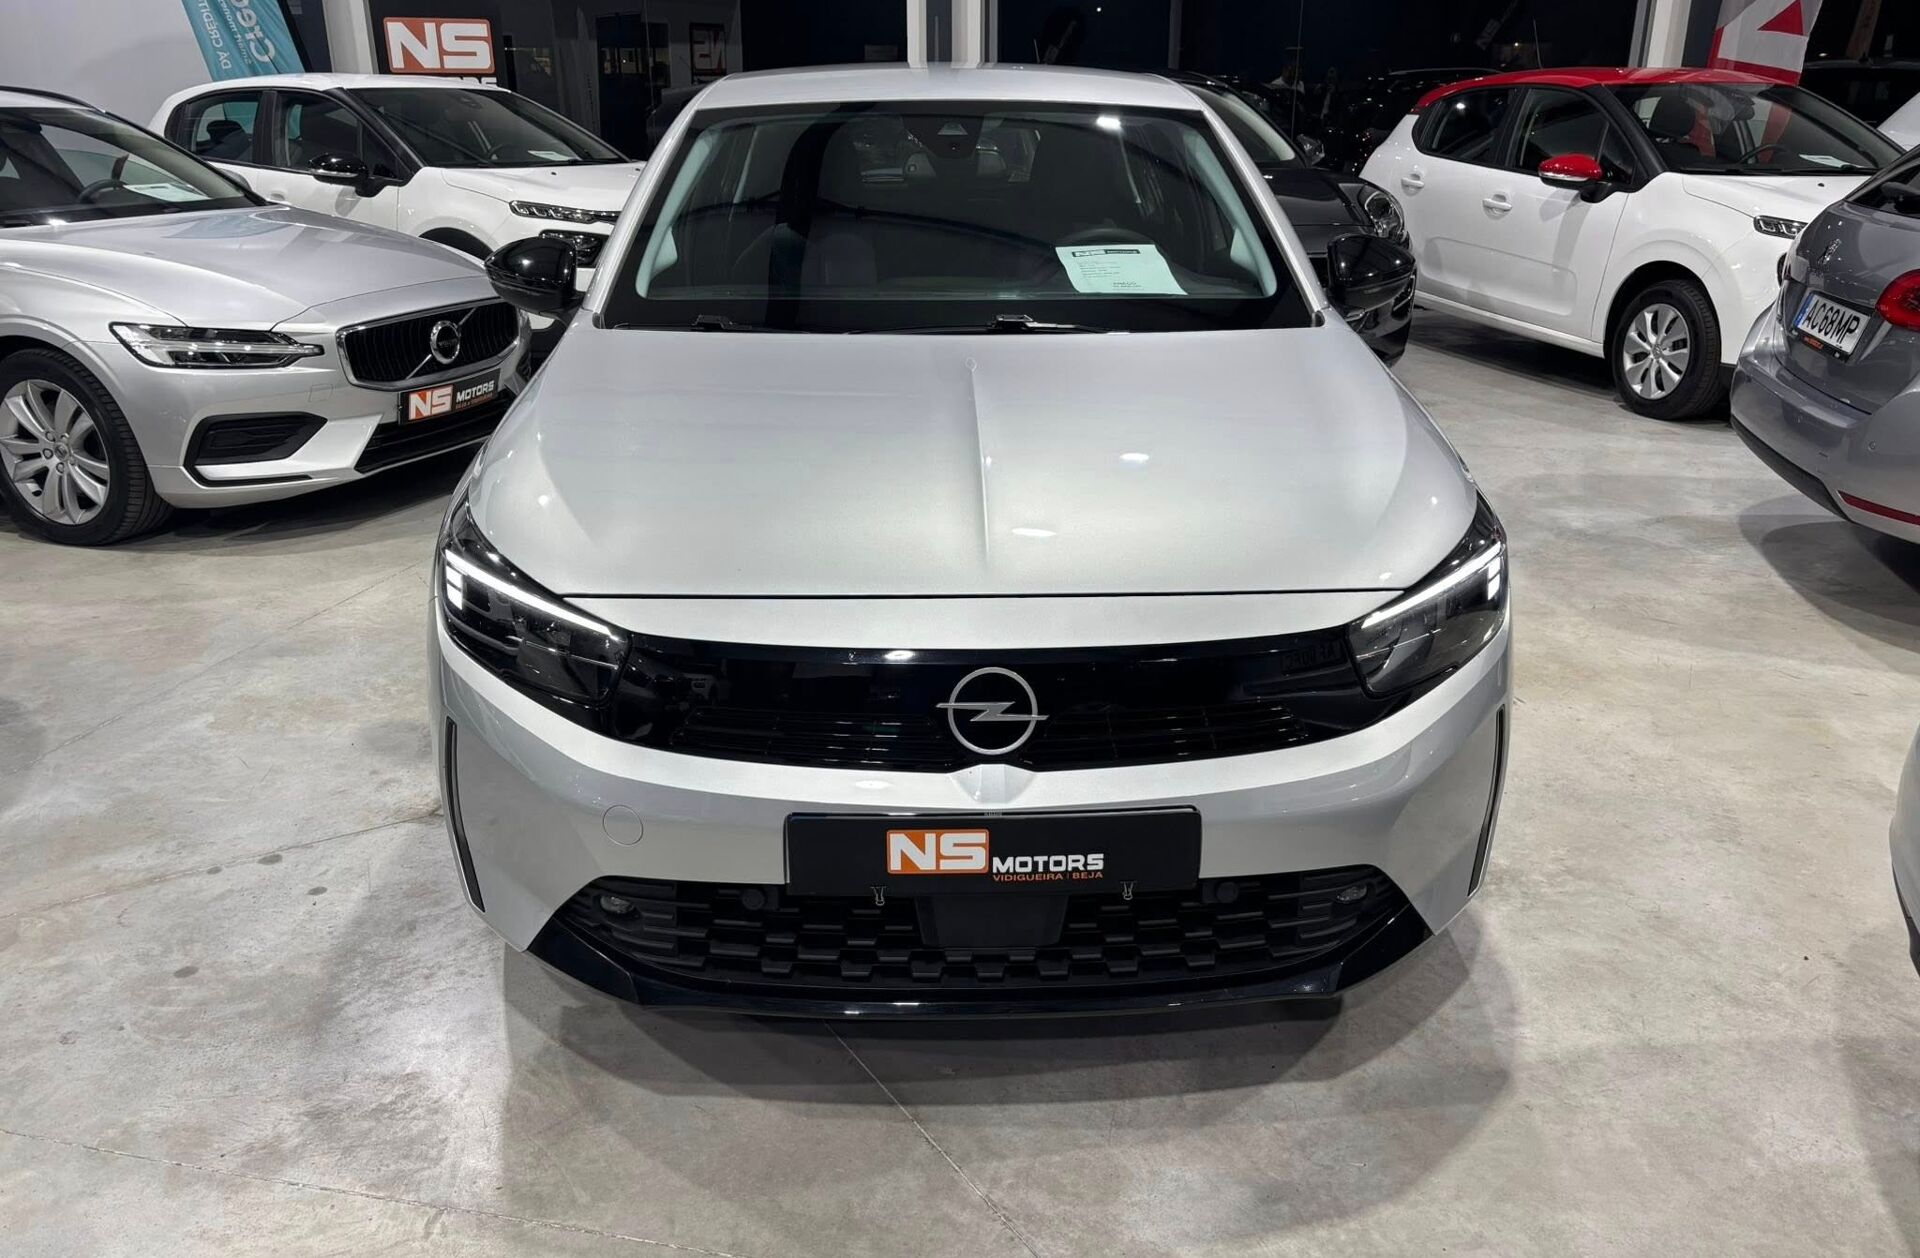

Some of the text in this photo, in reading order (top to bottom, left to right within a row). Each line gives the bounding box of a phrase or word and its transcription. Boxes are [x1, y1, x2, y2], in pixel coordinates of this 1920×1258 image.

[386, 21, 491, 69] NS
[1802, 299, 1861, 344] AC68MP
[409, 385, 453, 420] NS
[456, 380, 495, 402] MOTORS
[889, 832, 1104, 874] NS MOTORS
[992, 871, 1104, 882] VIDIGUEIRA BEJA
